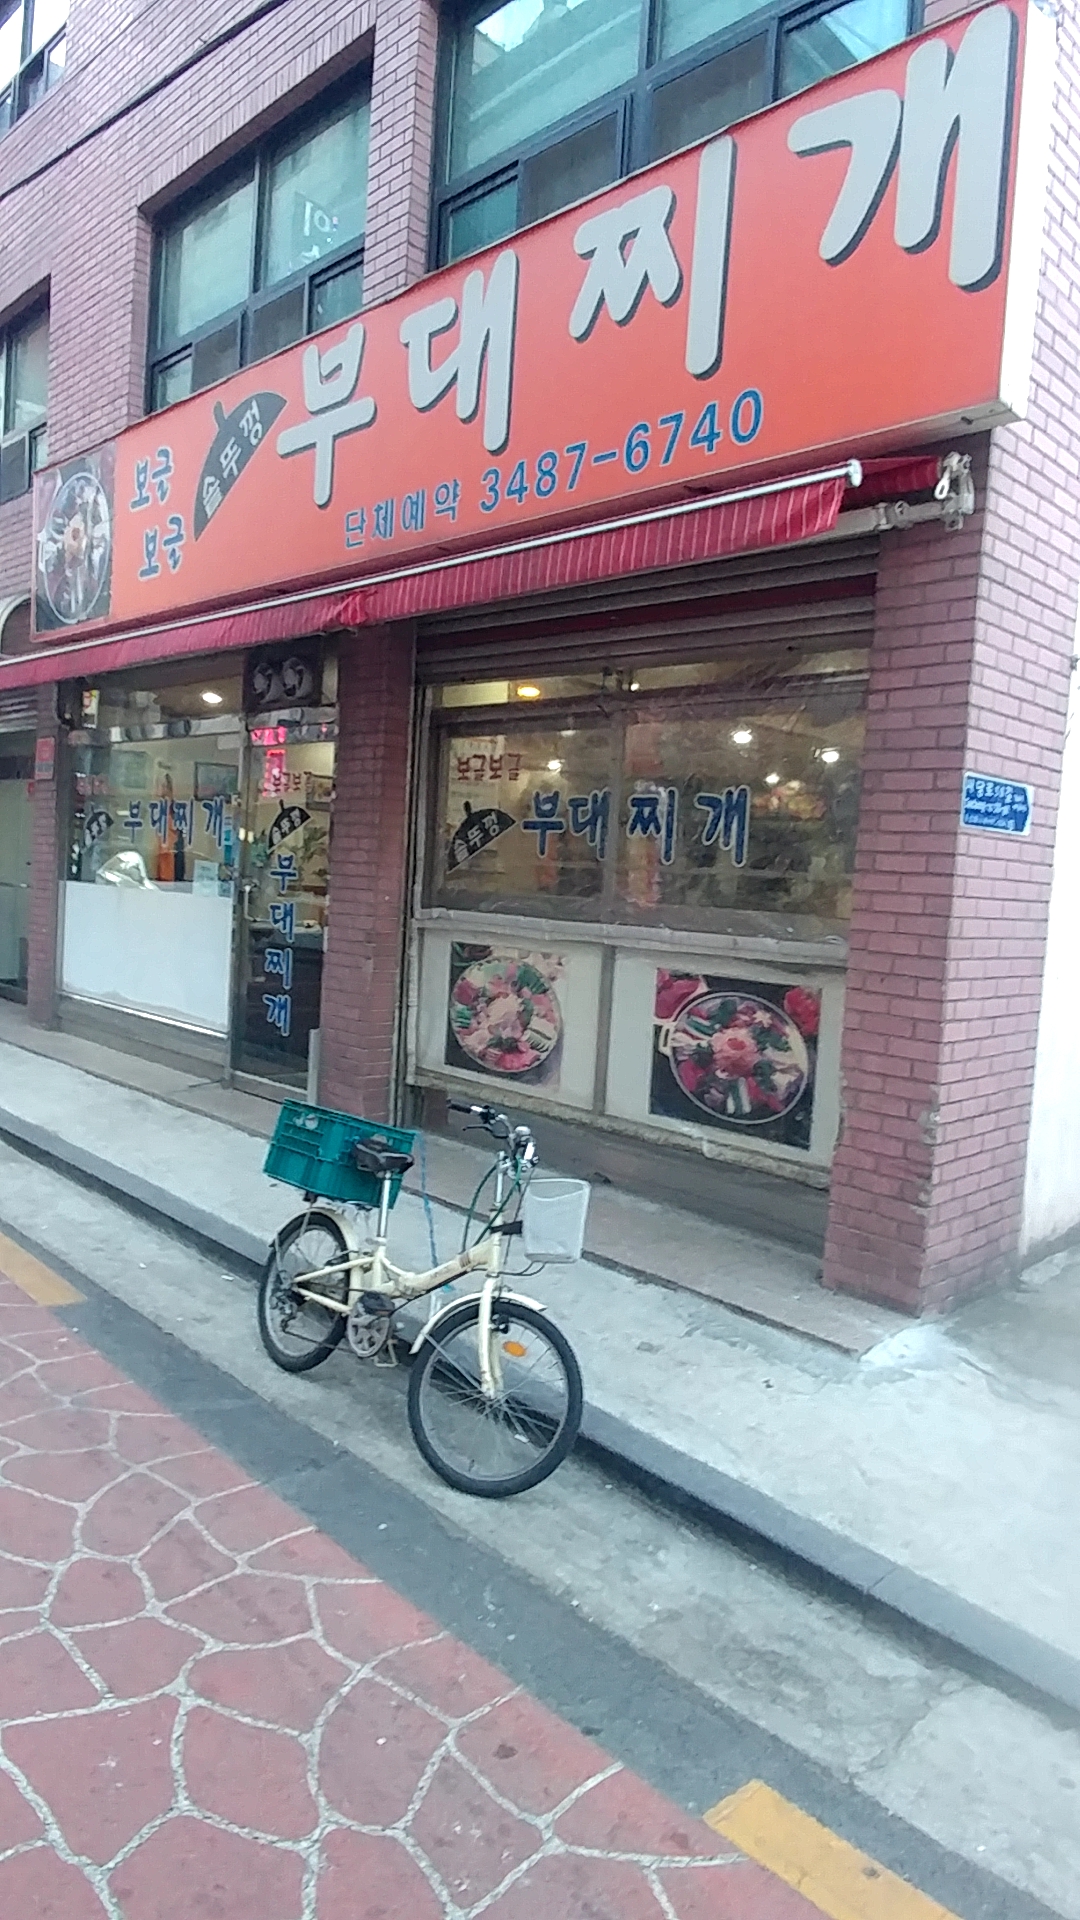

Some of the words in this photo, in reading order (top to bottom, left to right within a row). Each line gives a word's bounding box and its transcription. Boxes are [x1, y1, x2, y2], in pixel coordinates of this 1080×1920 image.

[277, 5, 1018, 509] 부대찌개
[130, 446, 174, 512] 보글
[203, 399, 263, 519] 솥뚜껑
[344, 478, 461, 549] 단체예약
[479, 388, 764, 512] 3487-6740
[138, 514, 185, 582] 보글
[457, 753, 522, 781] 보글보글
[123, 795, 225, 848] 부대찌개
[521, 785, 750, 867] 부대찌개
[263, 853, 298, 1037] 부대찌개
